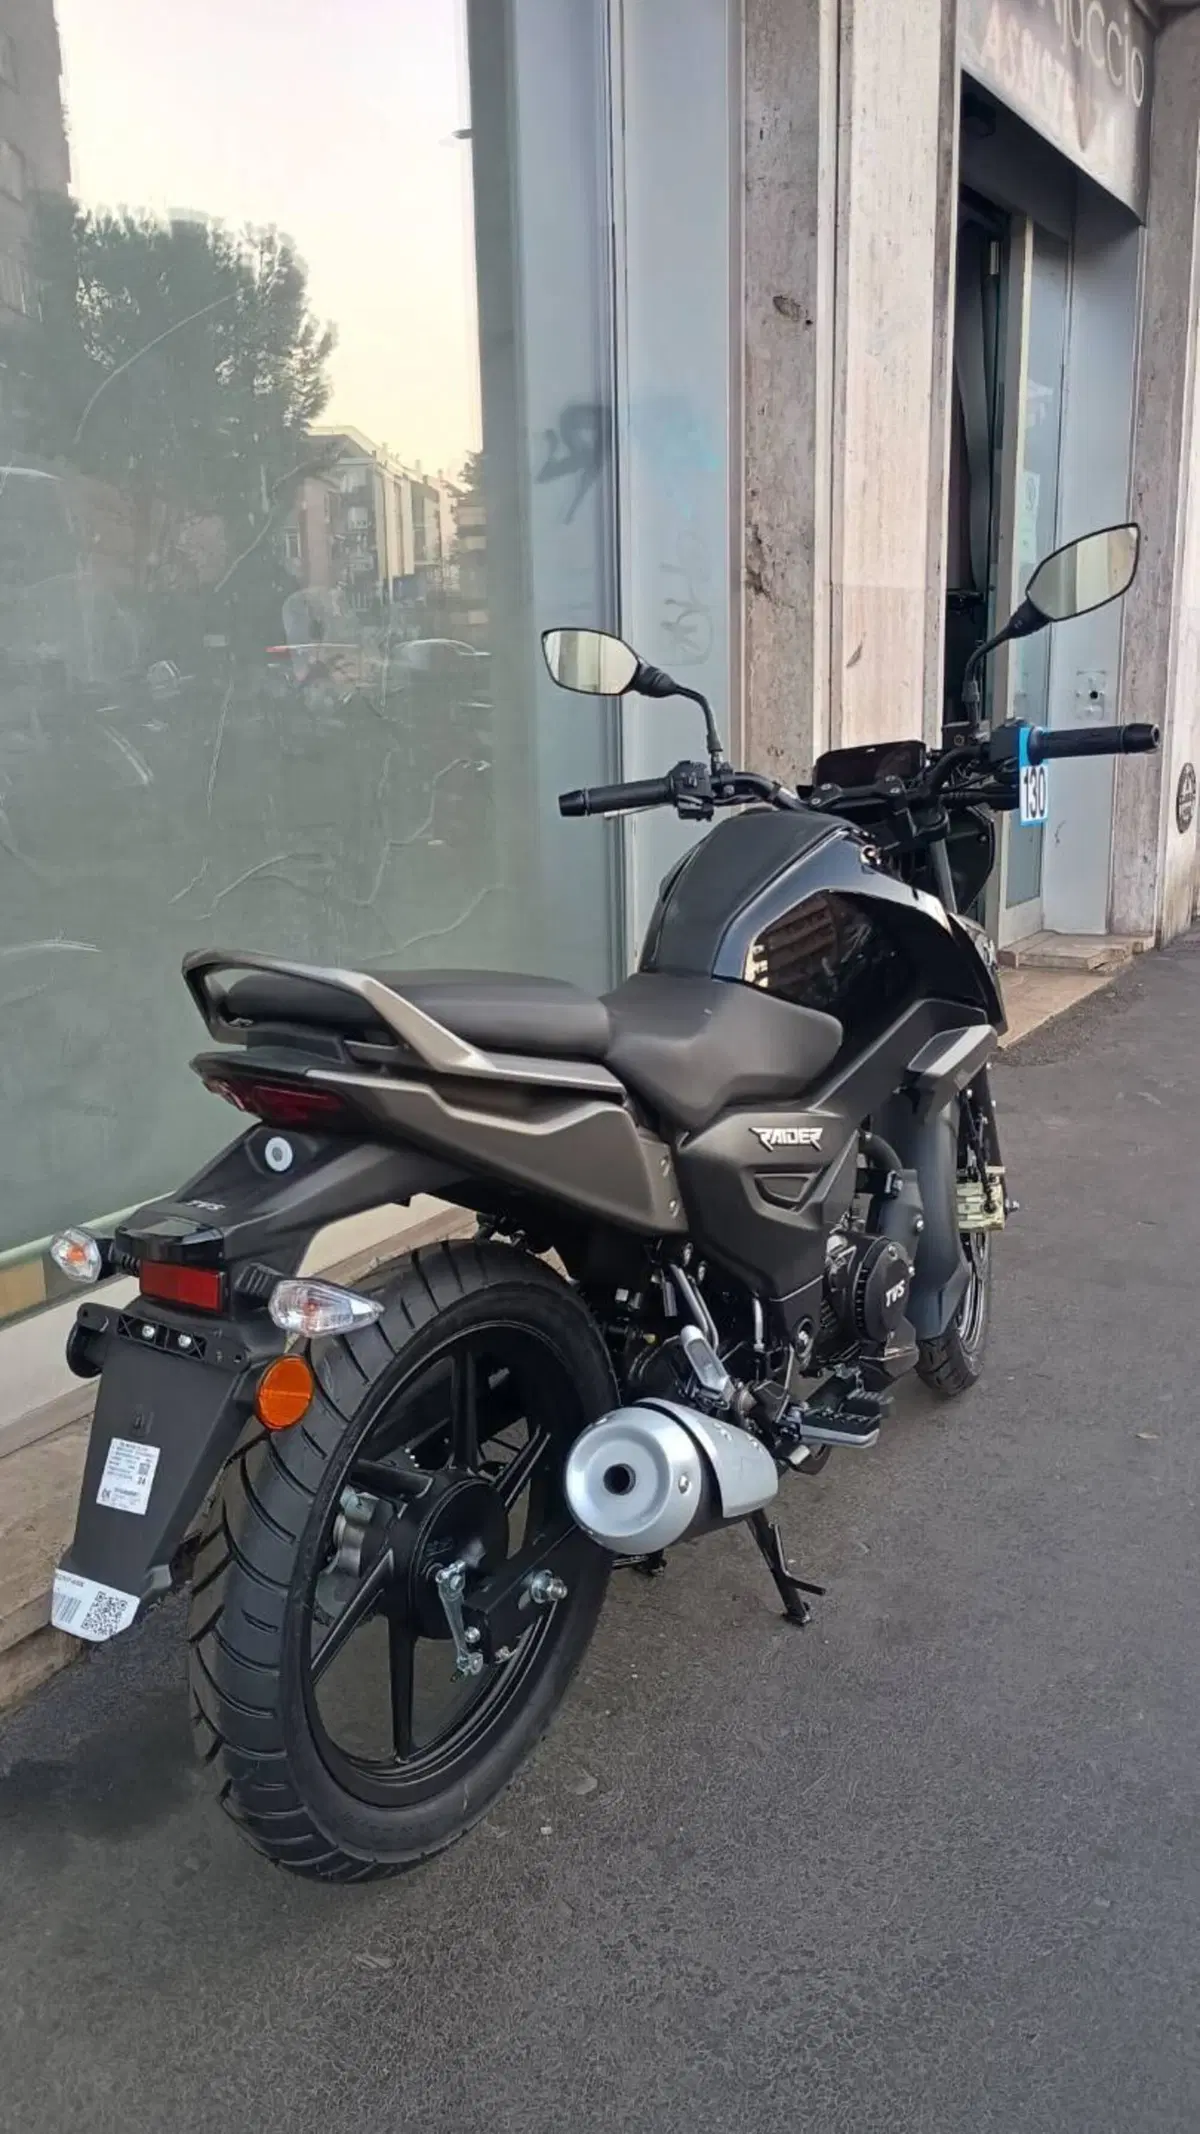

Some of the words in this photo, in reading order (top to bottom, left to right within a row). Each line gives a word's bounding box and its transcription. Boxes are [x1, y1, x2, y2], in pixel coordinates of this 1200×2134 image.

[1023, 766, 1046, 819] 130
[748, 1127, 823, 1152] RAIDER
[885, 1279, 905, 1307] TVS
